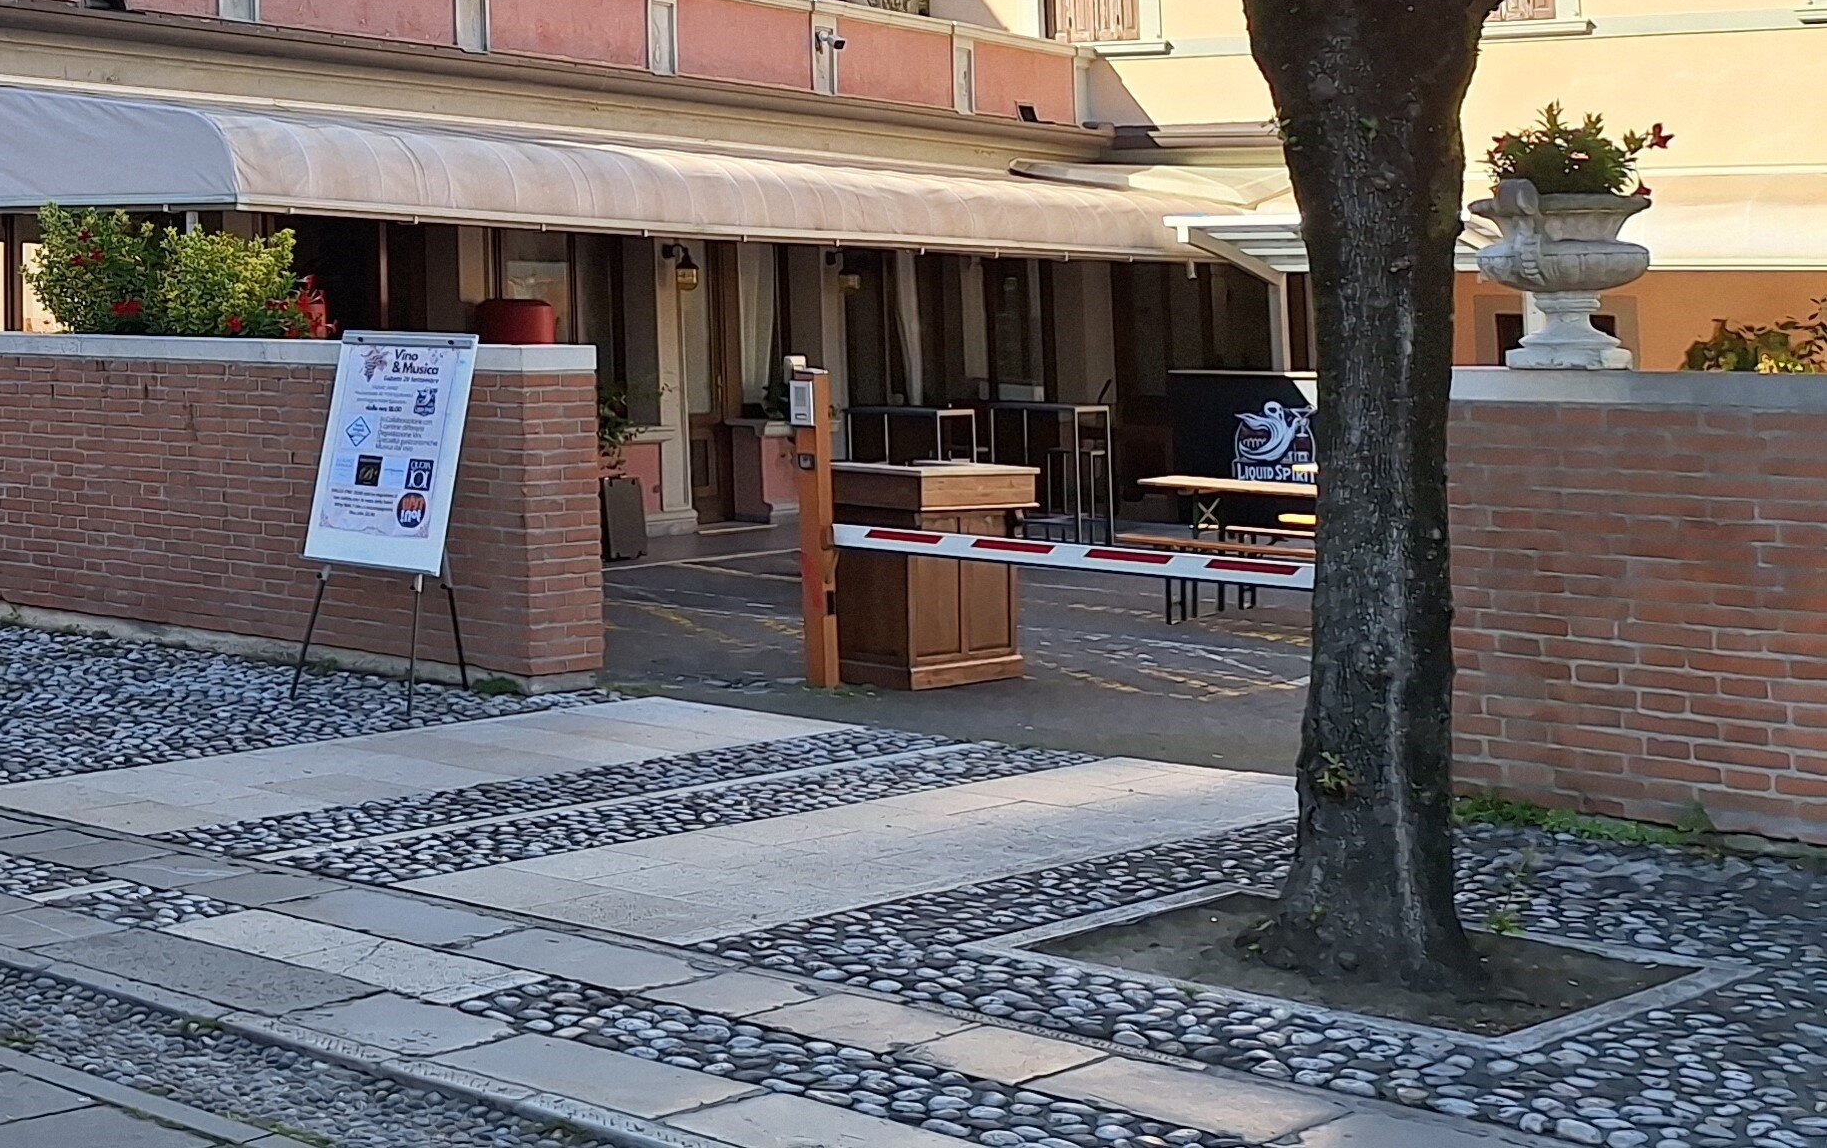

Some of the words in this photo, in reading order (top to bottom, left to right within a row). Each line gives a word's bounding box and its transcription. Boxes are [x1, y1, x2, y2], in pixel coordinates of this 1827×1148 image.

[395, 349, 418, 361] Vino
[392, 361, 400, 373] &
[403, 362, 439, 375] Musica
[1237, 463, 1274, 481] LIQUID
